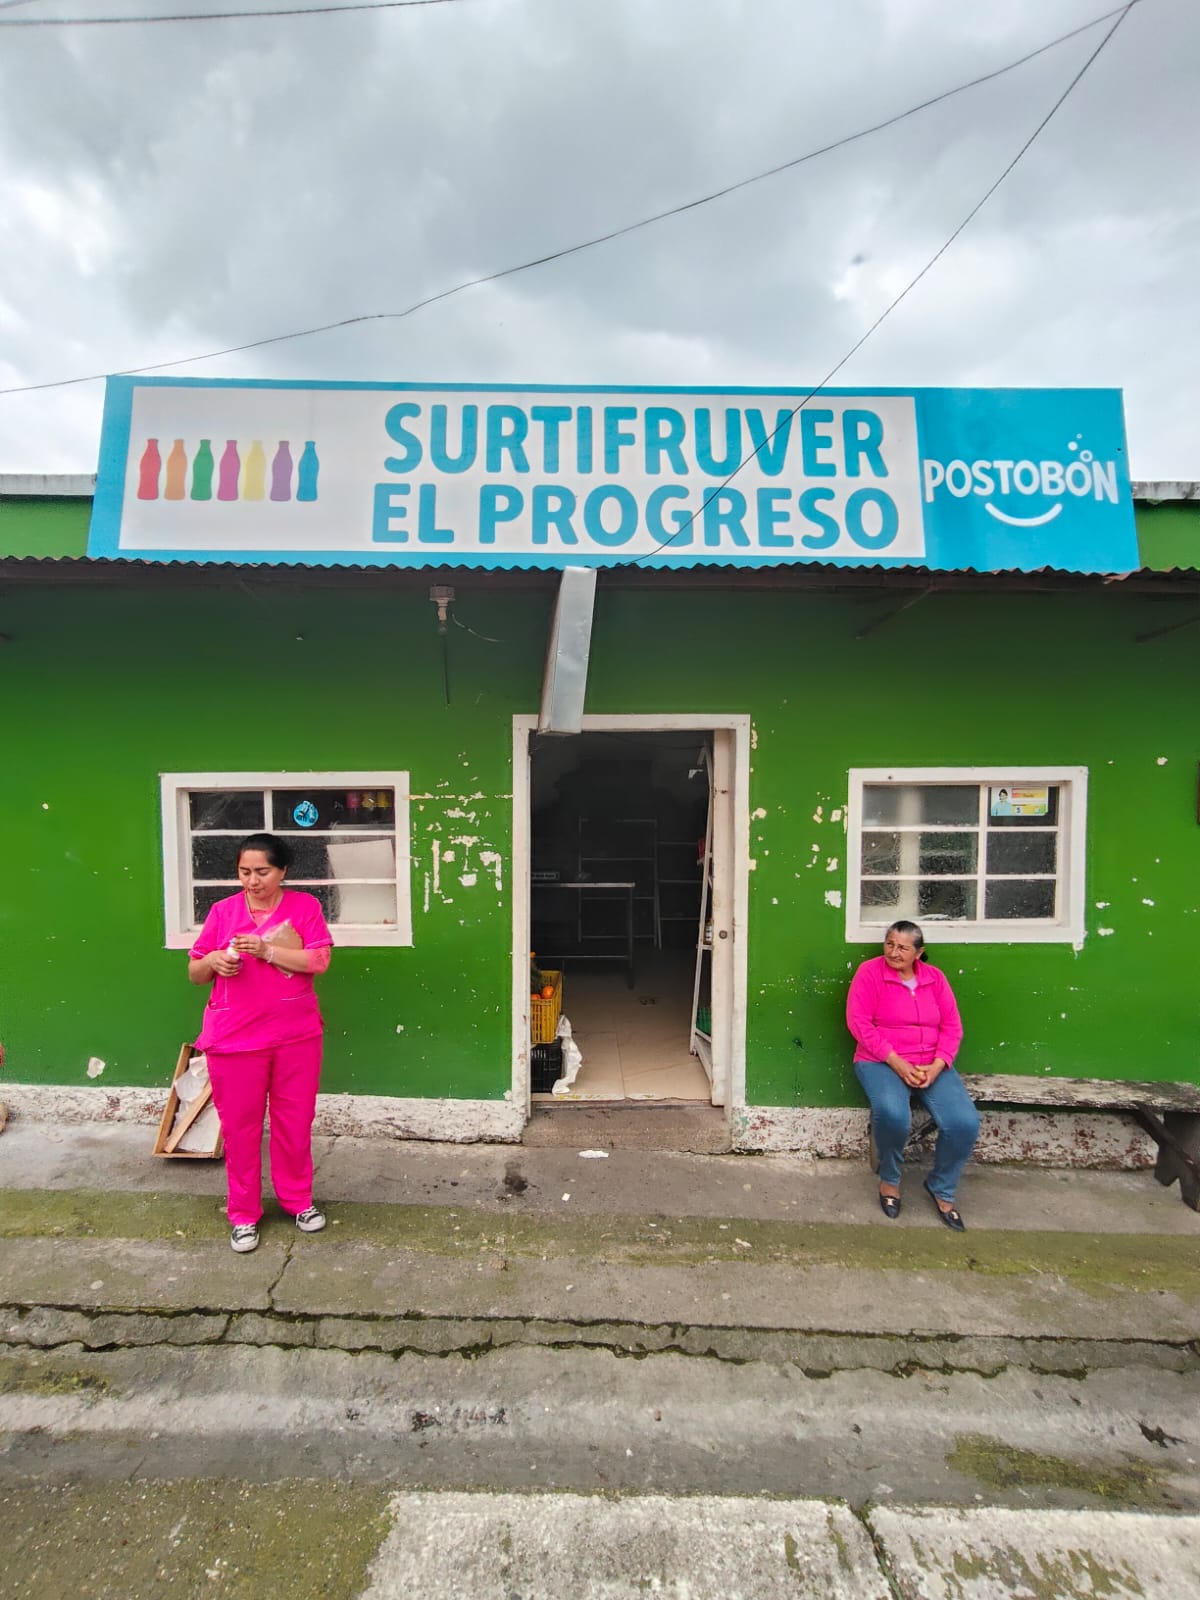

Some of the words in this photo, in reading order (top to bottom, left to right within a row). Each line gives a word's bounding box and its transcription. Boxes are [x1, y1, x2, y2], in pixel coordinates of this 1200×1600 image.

[385, 403, 889, 478] SURTIFRUVER
[372, 484, 455, 543] EL
[479, 484, 899, 550] PROGRESO
